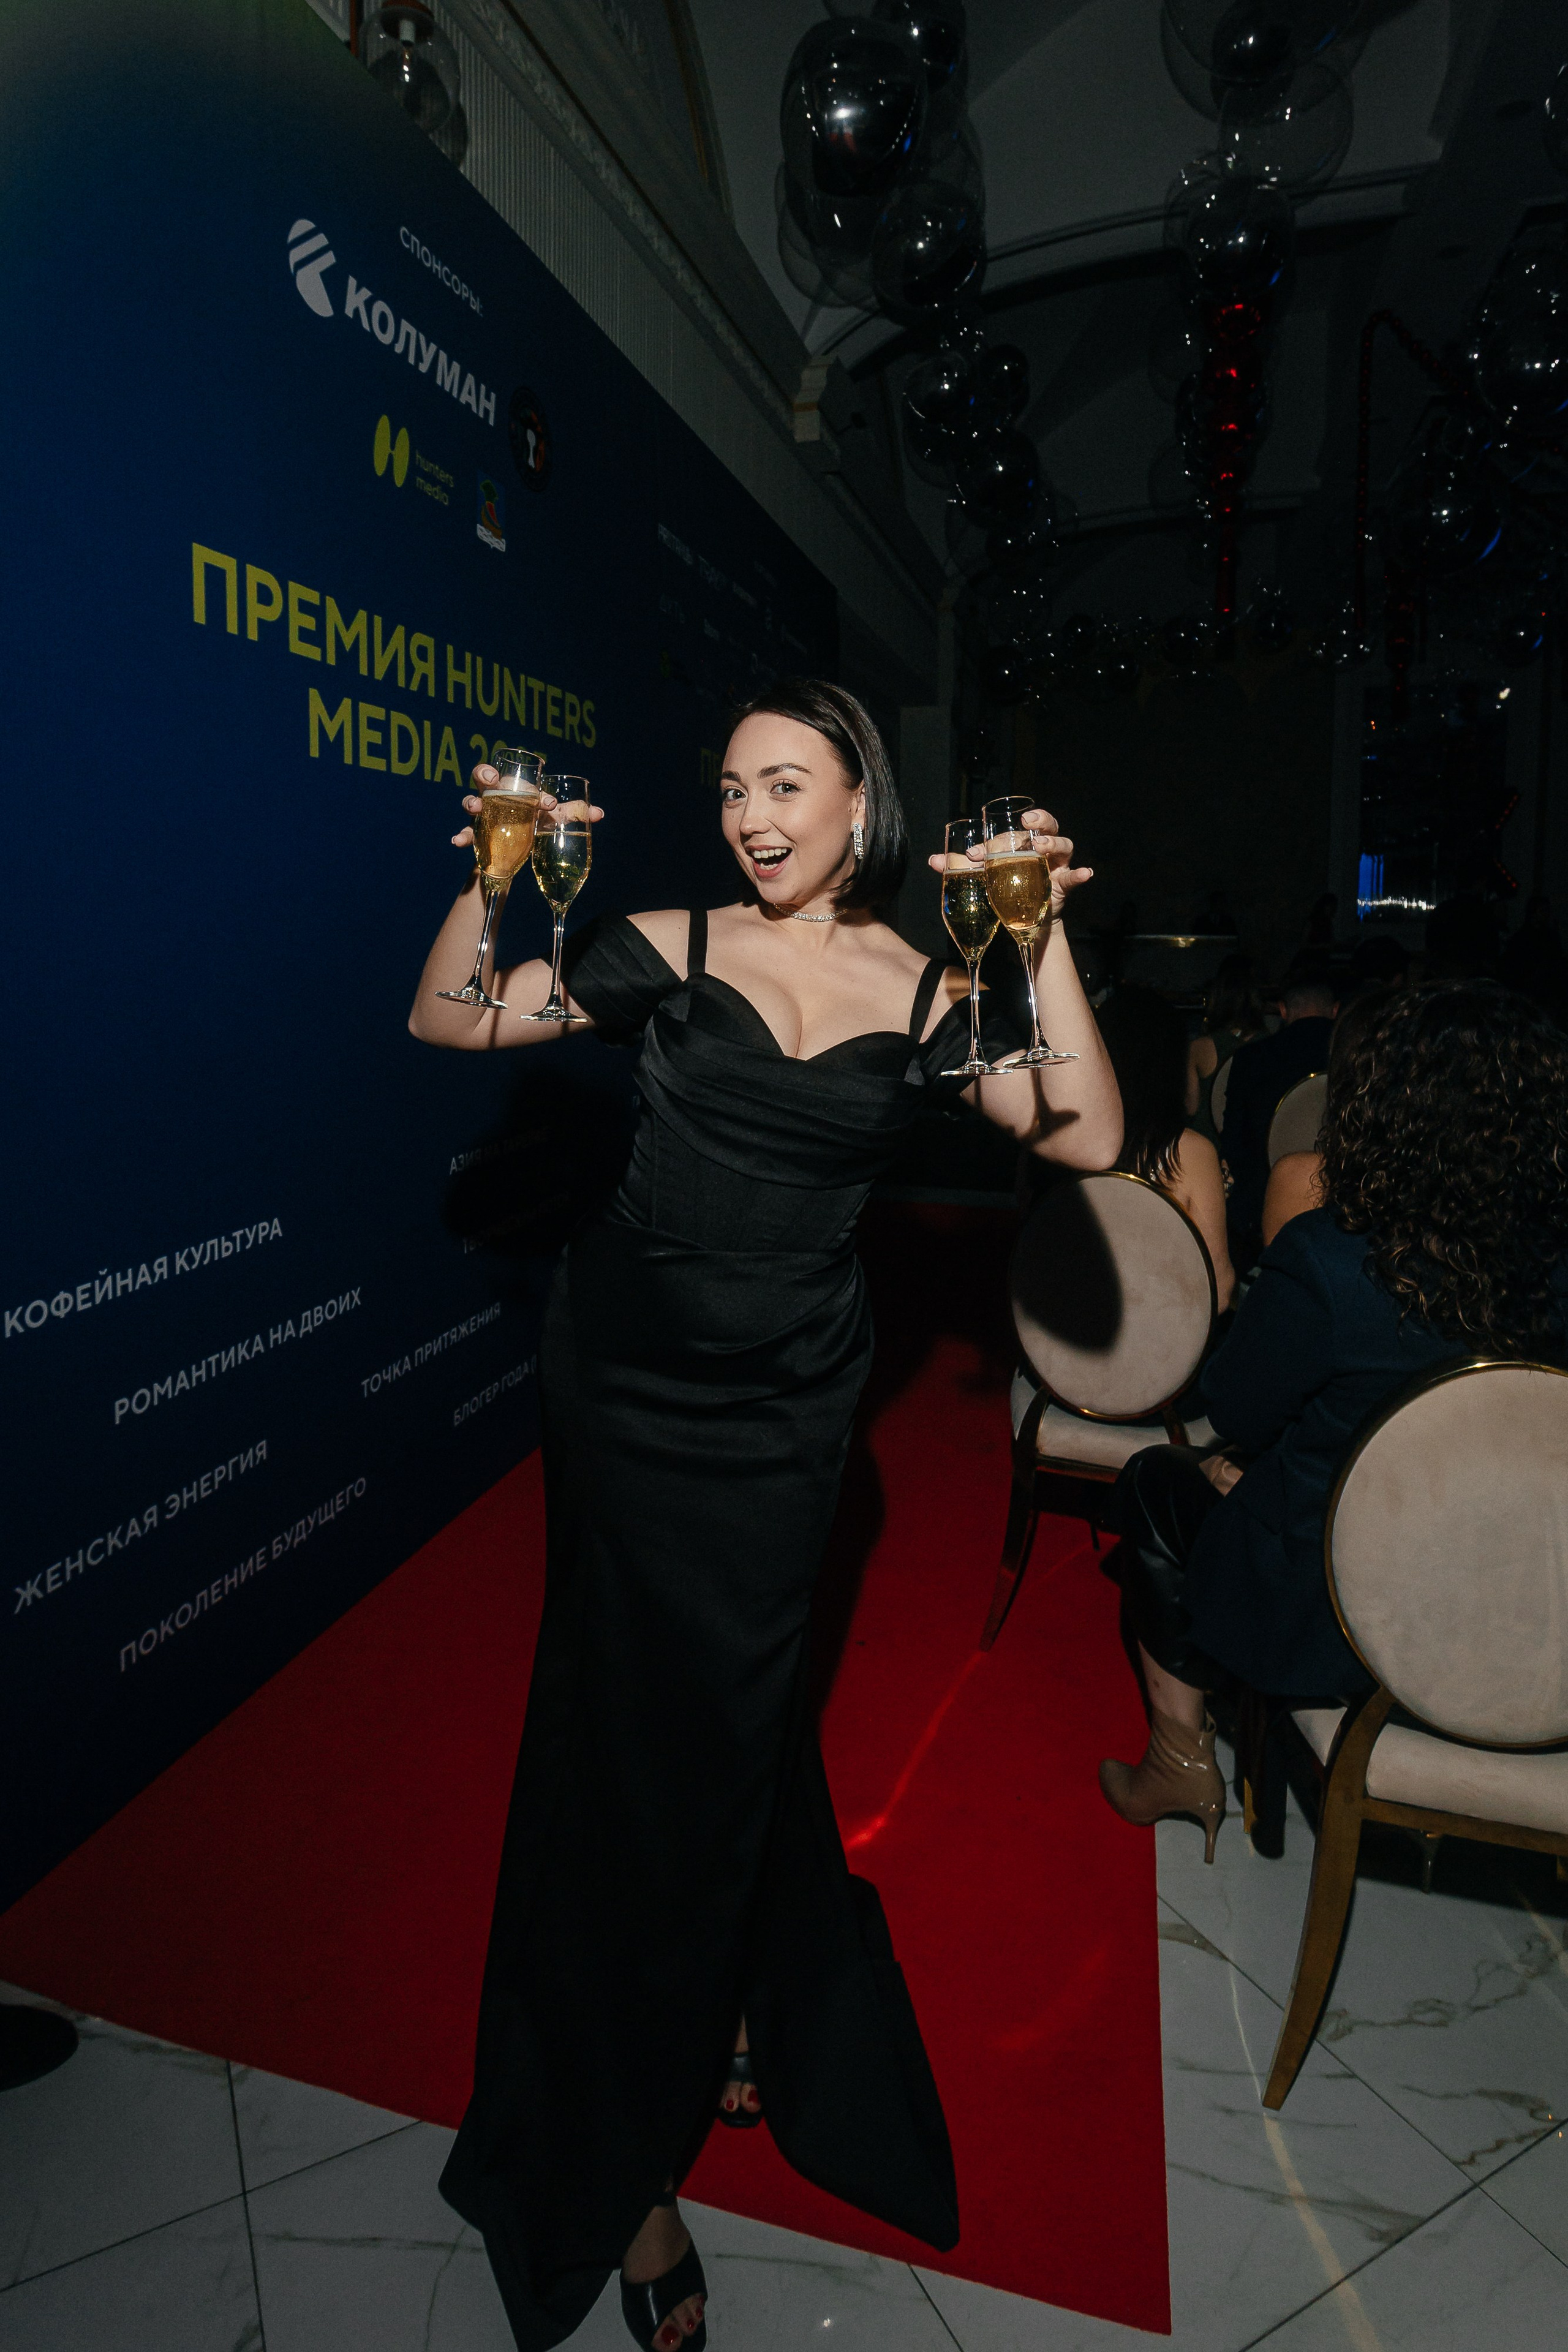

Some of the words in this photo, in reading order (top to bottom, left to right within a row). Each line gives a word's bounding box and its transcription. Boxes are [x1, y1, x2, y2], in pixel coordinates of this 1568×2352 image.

[399, 226, 483, 317] СПОНСОРЫ:
[344, 275, 496, 426] КОЛУМАН
[415, 450, 454, 488] hunters
[416, 476, 449, 506] media
[192, 542, 435, 697] ПРЕМИЯ
[446, 644, 595, 748] HUNTERS
[308, 687, 462, 786] MEDIA
[4, 1256, 168, 1338] КОФЕЙНАЯ
[175, 1218, 283, 1275] КУЛЬТУРА
[115, 1334, 265, 1425] РОМАНТИКА
[269, 1319, 296, 1349] НА
[299, 1286, 361, 1338] ДВОИХ
[361, 1355, 412, 1398] ТОЧКА
[414, 1302, 500, 1367] ПРИТЯЖЕНИЯ
[453, 1381, 499, 1427] БЛОГЕР
[501, 1362, 529, 1392] ГОДА
[14, 1504, 158, 1614] ЖЕНСКАЯ
[165, 1439, 267, 1520] ЭНЕРГИЯ
[120, 1547, 267, 1672] ПОКОЛЕНИЕ
[272, 1477, 366, 1559] БУДУЩЕГО
